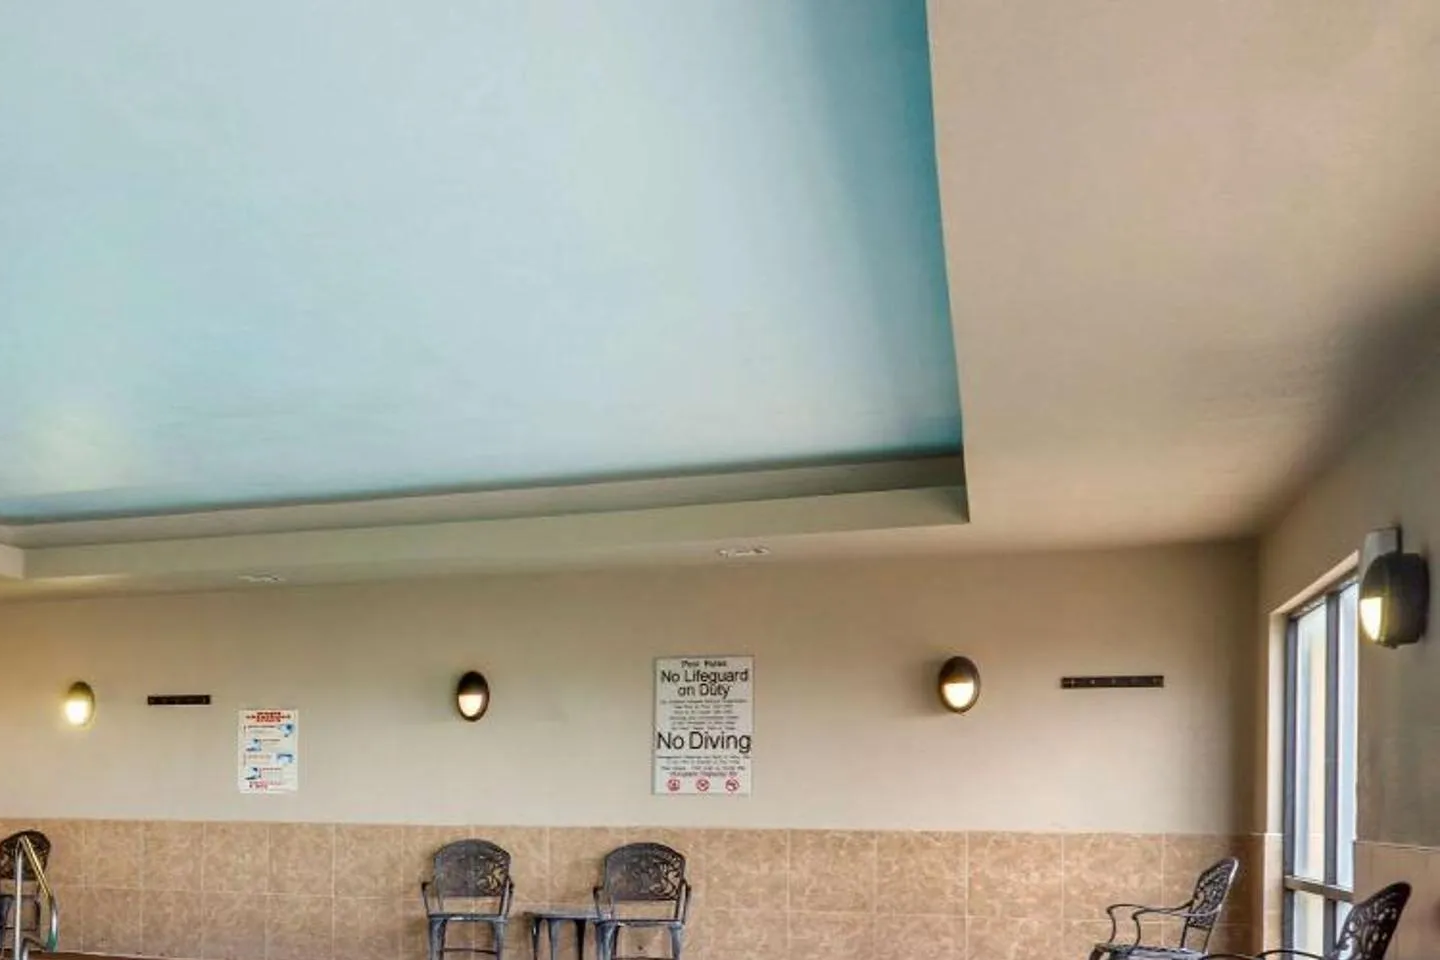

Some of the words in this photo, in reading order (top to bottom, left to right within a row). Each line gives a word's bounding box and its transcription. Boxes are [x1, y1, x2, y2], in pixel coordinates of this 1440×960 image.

[661, 670, 680, 682] No
[685, 668, 748, 684] Lifeguard
[700, 683, 731, 699] Duty
[657, 731, 684, 750] No
[689, 731, 752, 754] Diving
